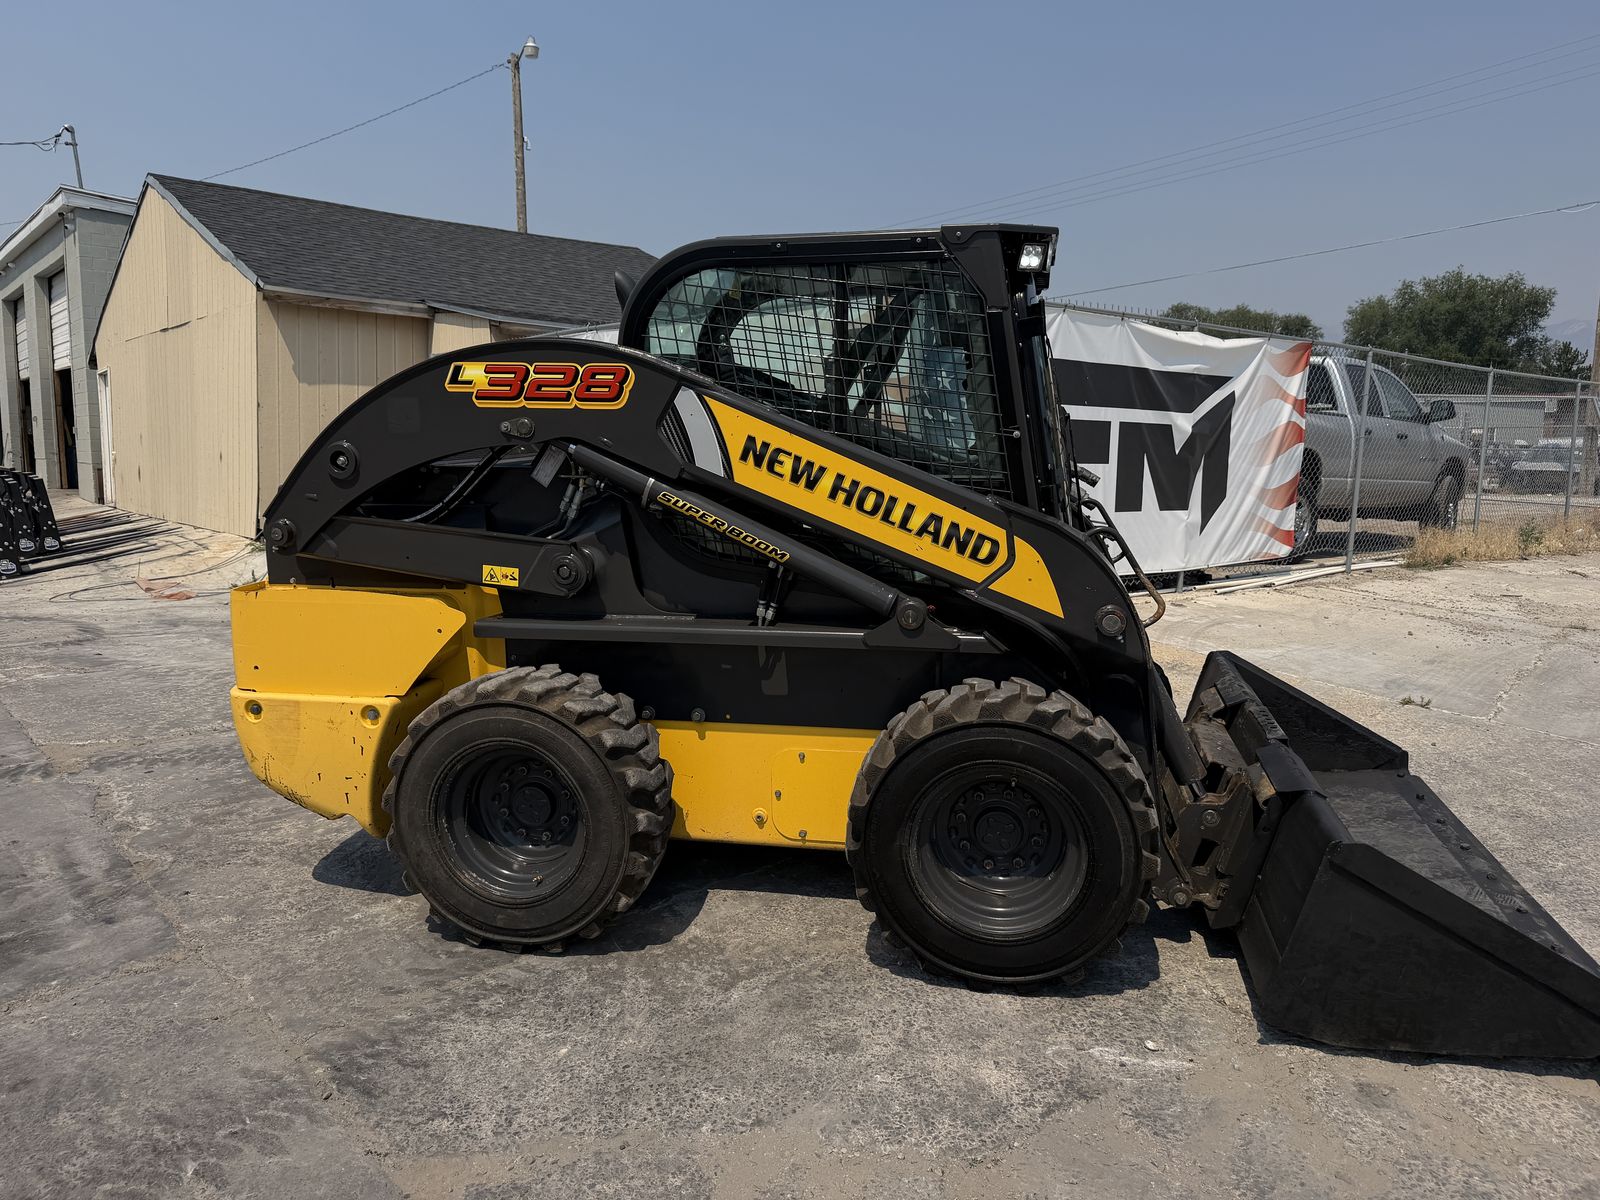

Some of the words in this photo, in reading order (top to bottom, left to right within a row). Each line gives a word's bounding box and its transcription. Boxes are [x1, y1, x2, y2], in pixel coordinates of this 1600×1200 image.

[446, 363, 633, 406] L328
[657, 491, 728, 532] SUPER
[726, 525, 790, 563] BOOM
[738, 434, 827, 492] NEW
[826, 471, 1001, 567] HOLLAND
